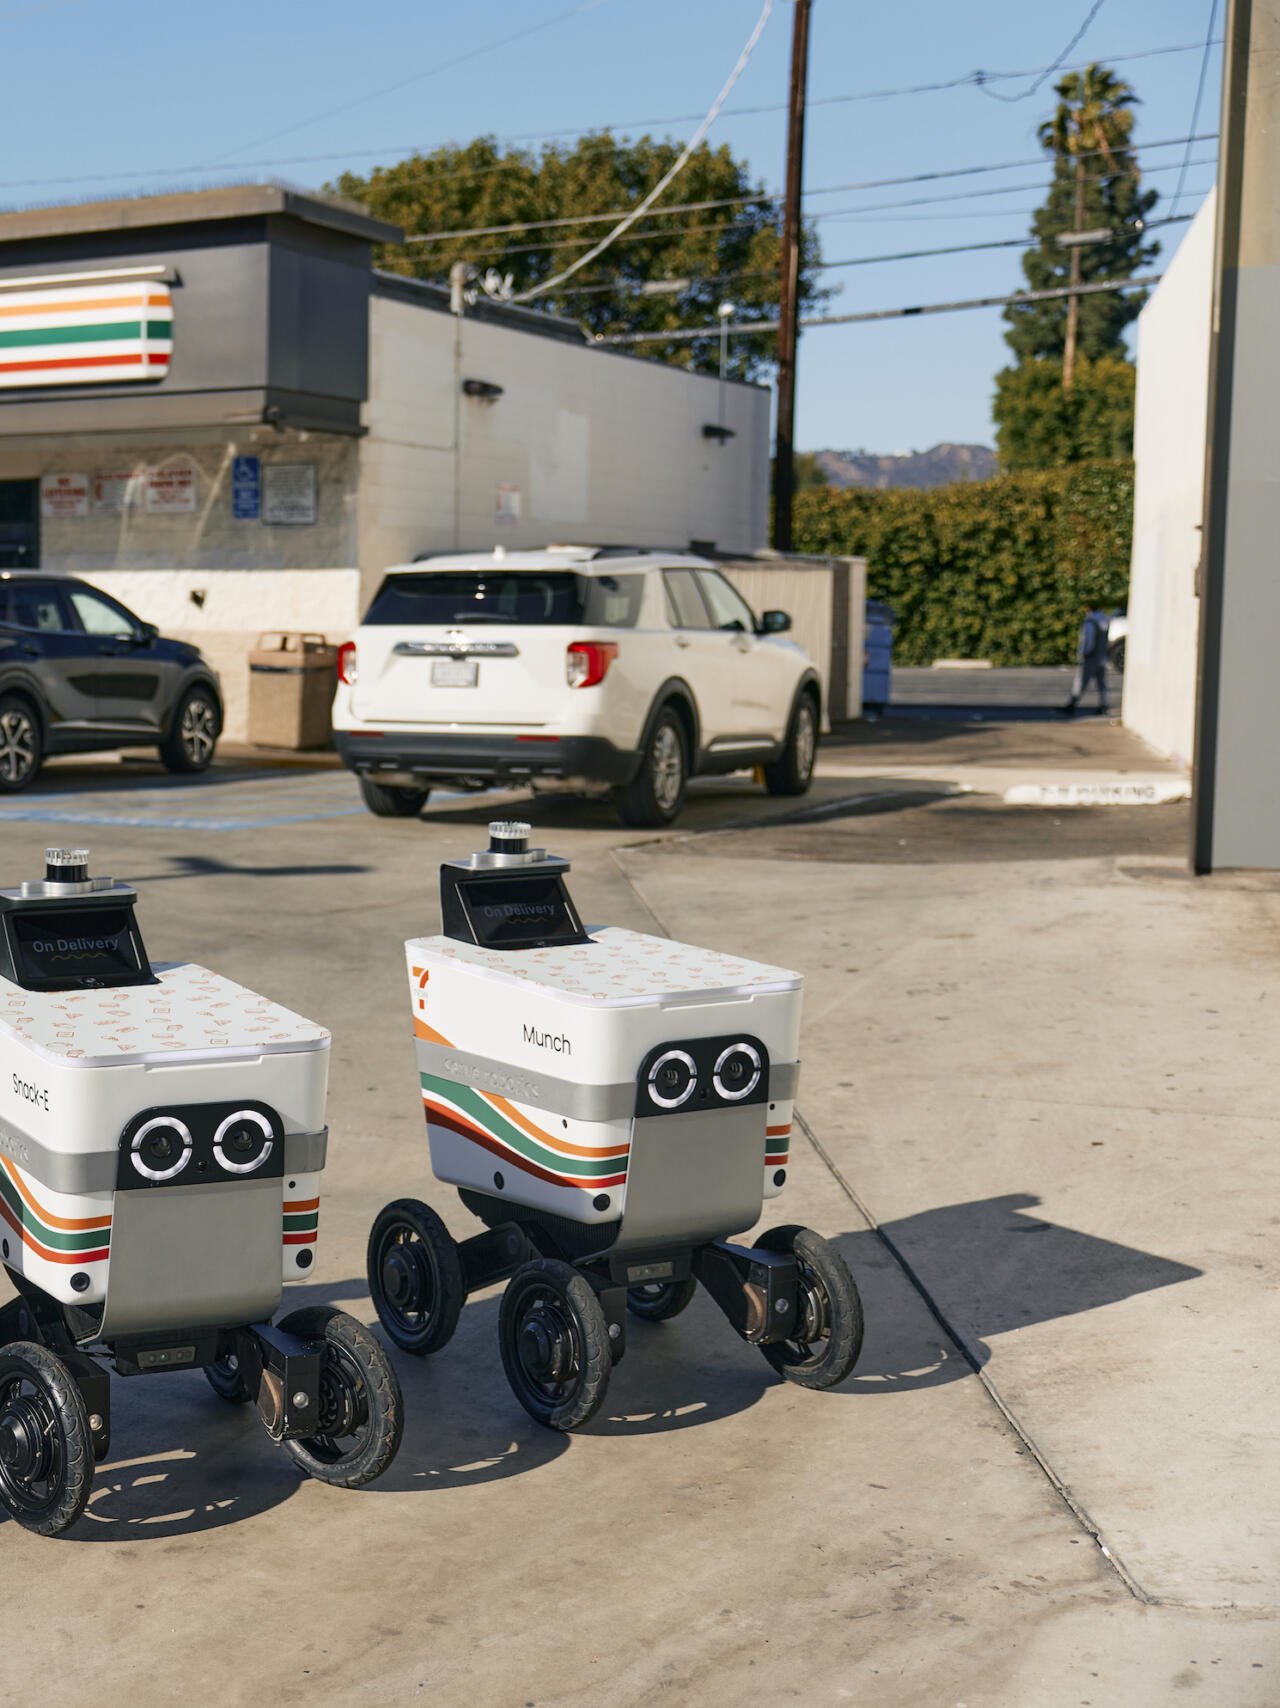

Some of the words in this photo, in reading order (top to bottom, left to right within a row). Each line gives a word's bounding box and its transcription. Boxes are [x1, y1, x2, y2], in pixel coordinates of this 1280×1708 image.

[483, 905, 502, 917] On
[504, 903, 555, 916] Delivery
[32, 940, 55, 953] On
[57, 938, 119, 951] Delivery
[412, 966, 429, 1010] 7
[523, 1023, 572, 1056] Munch
[12, 1073, 50, 1112] Snack-E
